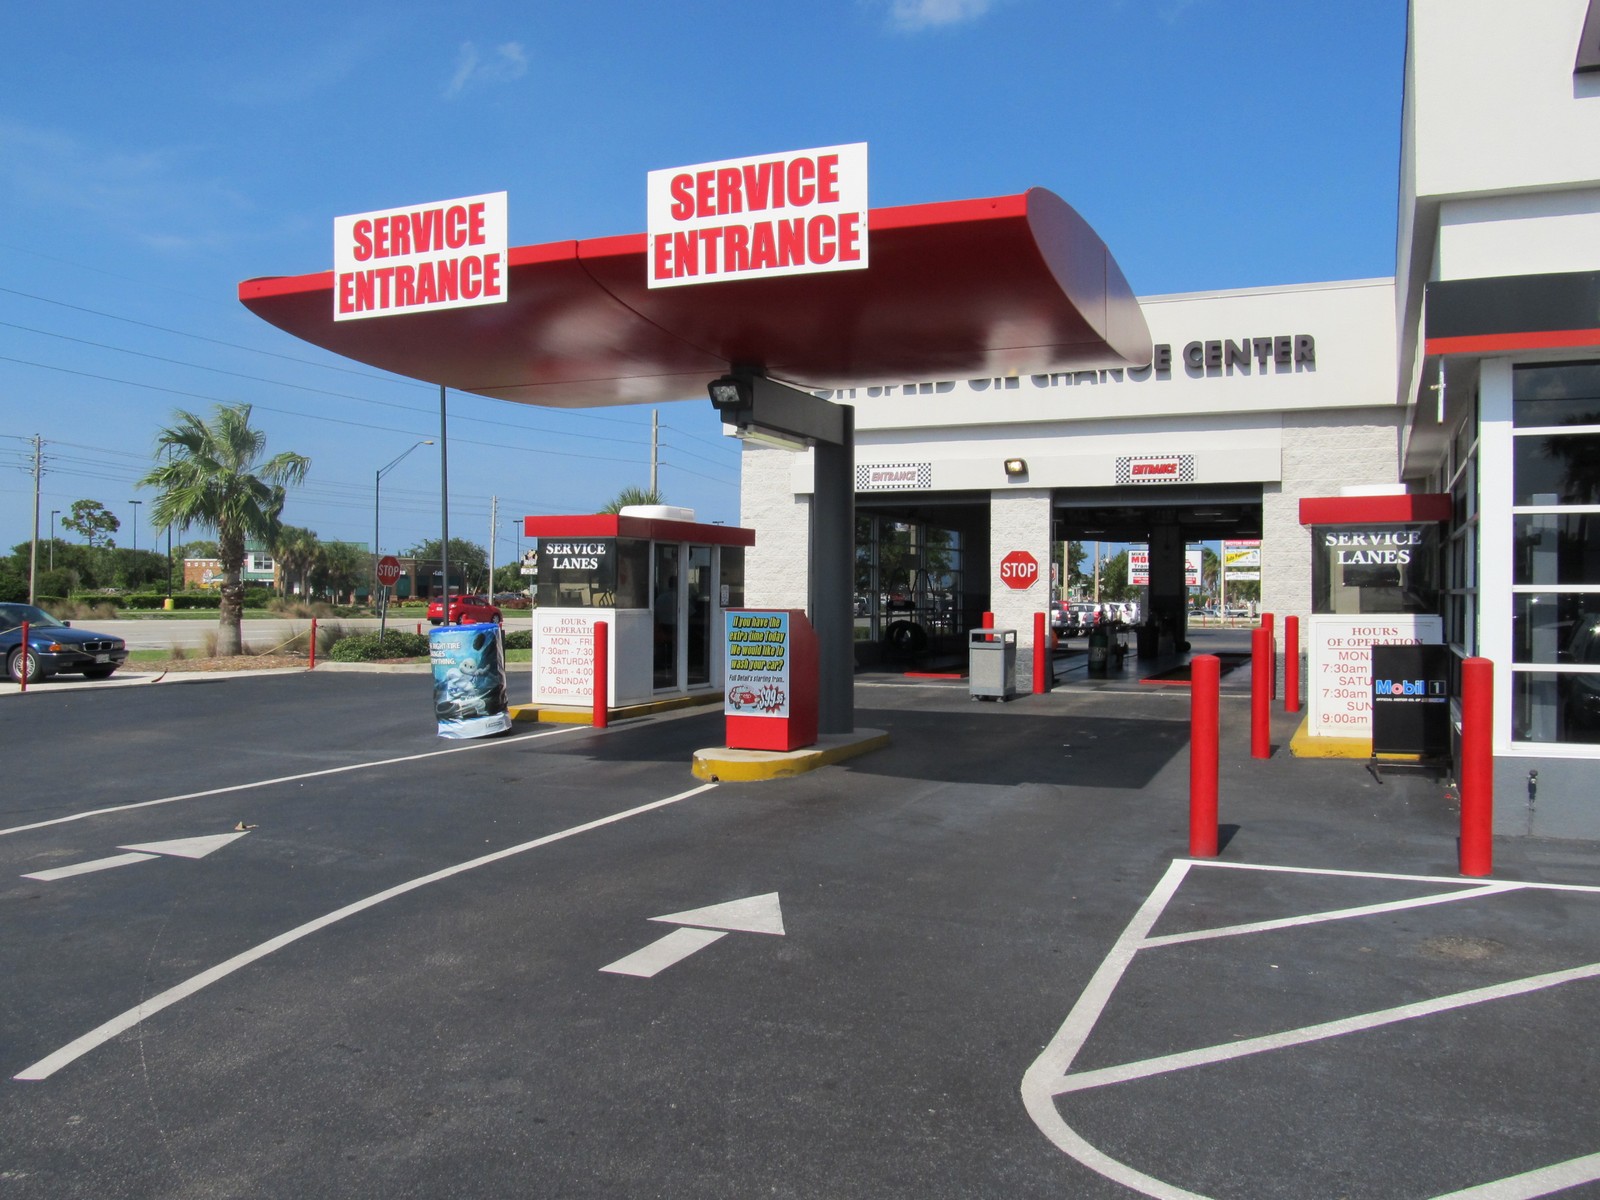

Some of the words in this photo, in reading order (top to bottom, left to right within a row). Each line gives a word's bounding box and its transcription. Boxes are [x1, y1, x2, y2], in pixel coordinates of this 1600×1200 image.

[671, 154, 839, 221] SERVICE
[353, 202, 486, 262] SERVICE
[654, 212, 860, 280] ENTRANCE
[339, 253, 501, 314] ENTRANCE
[1183, 334, 1316, 368] CENTER
[1132, 463, 1177, 475] ENTRANCE
[871, 471, 916, 482] ENTRANCE
[1325, 531, 1422, 546] SERVICE
[545, 543, 606, 555] SERVICE
[1337, 549, 1411, 565] LANES
[552, 557, 598, 570] LANES
[378, 565, 400, 577] STOP
[1002, 562, 1036, 578] STOP
[739, 617, 751, 628] you
[751, 616, 769, 628] have
[769, 616, 781, 628] the
[542, 626, 554, 634] OF
[555, 626, 594, 634] OPERATIO
[1352, 627, 1398, 636] HOURS
[729, 630, 748, 642] extra
[749, 630, 764, 642] time
[765, 630, 785, 644] Today
[1327, 638, 1344, 647] OF
[1347, 638, 1423, 646] OPERATION
[540, 647, 569, 655] 7:30am
[576, 648, 593, 656] 7:30
[730, 644, 741, 656] We
[742, 645, 762, 656] would
[762, 645, 776, 656] like
[776, 645, 784, 657] to
[550, 657, 594, 666] SATURDAY
[731, 659, 749, 670] wash
[749, 659, 766, 671] your
[766, 659, 784, 671] car?
[540, 667, 569, 675] 7:30am
[576, 668, 593, 676] 4:00
[1322, 664, 1367, 673] 7:30am
[555, 677, 589, 685] SUNDAY
[753, 675, 771, 683] starting
[1339, 676, 1373, 686] SATU
[540, 686, 569, 694] 9:00am
[575, 688, 593, 696] 4:00
[1375, 679, 1425, 695] Mobil
[1322, 689, 1367, 698] 7:30am
[1346, 701, 1373, 711] SUN
[1322, 713, 1368, 723] 9:00am
